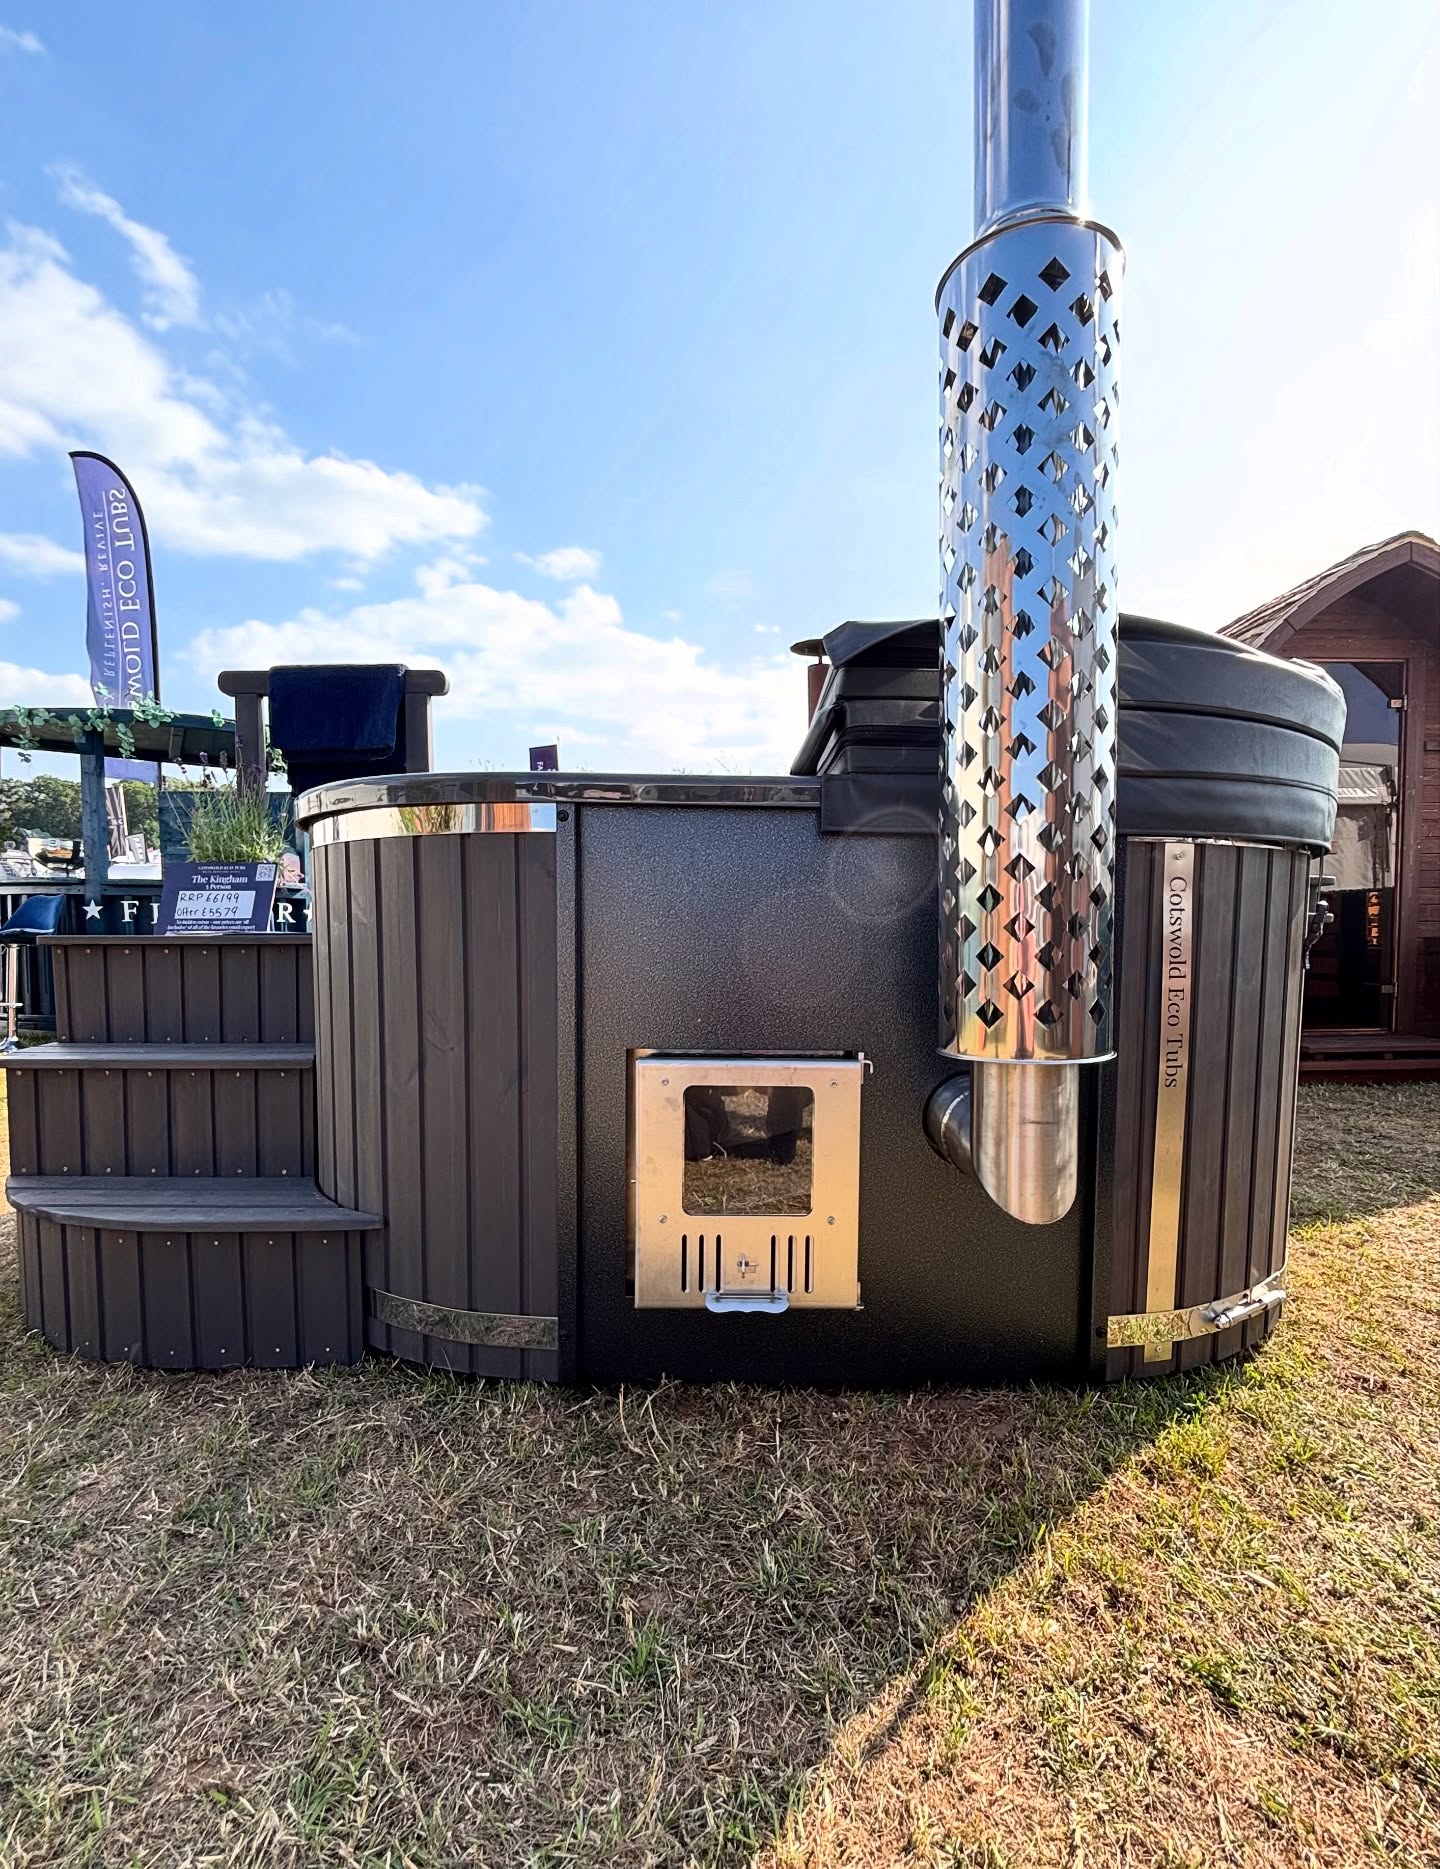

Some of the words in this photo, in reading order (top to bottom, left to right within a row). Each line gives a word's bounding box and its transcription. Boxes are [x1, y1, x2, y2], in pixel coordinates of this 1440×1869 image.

[180, 892, 204, 902] RRP
[206, 892, 240, 904] £6199
[192, 875, 209, 884] The
[209, 874, 248, 885] Kingham
[1168, 876, 1188, 980] Cotswold
[1167, 987, 1185, 1027] Eco
[1164, 1033, 1184, 1089] Tubs
